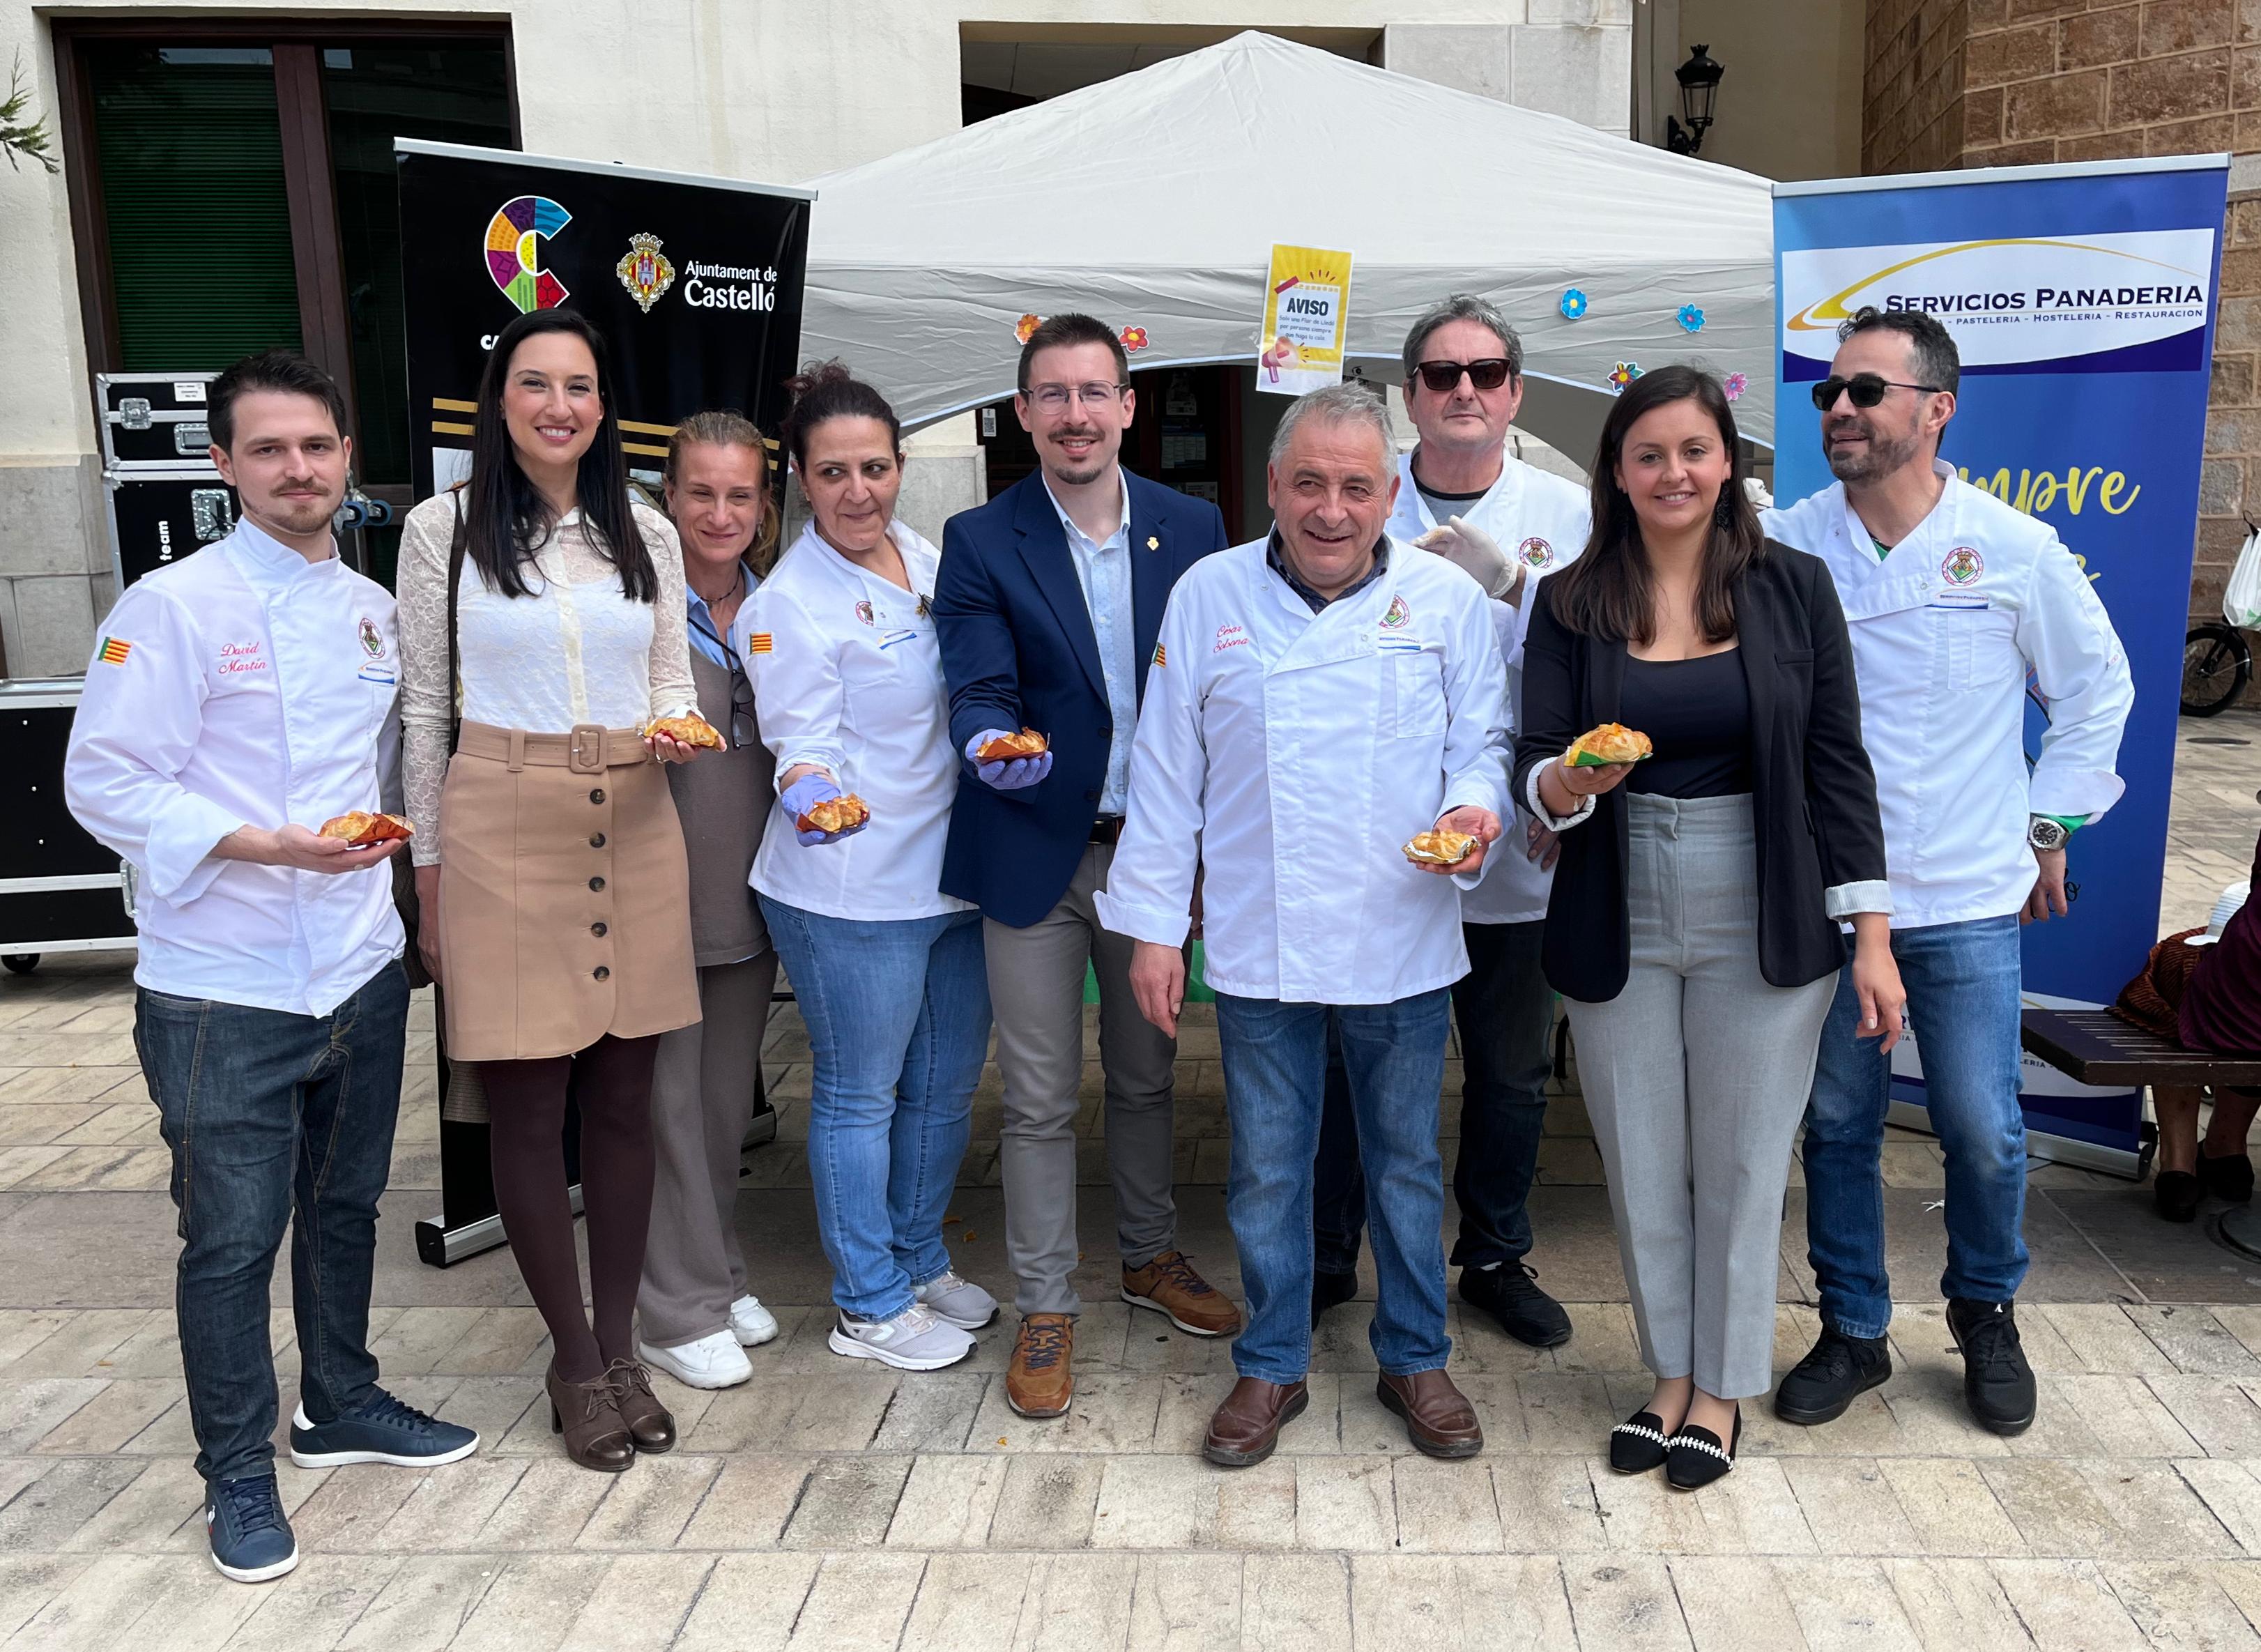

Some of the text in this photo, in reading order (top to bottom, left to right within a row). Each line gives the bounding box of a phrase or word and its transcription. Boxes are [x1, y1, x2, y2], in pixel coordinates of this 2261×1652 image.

[684, 260, 777, 282] Ajuntament de
[684, 279, 775, 312] Castelló
[1886, 285, 2204, 313] SERVICIOS PANADERIA
[1287, 298, 1328, 316] AVISO
[1956, 309, 2203, 326] PASTELERIA HOSTELERIA RESTAURACION
[158, 521, 172, 560] team
[220, 641, 260, 657] David
